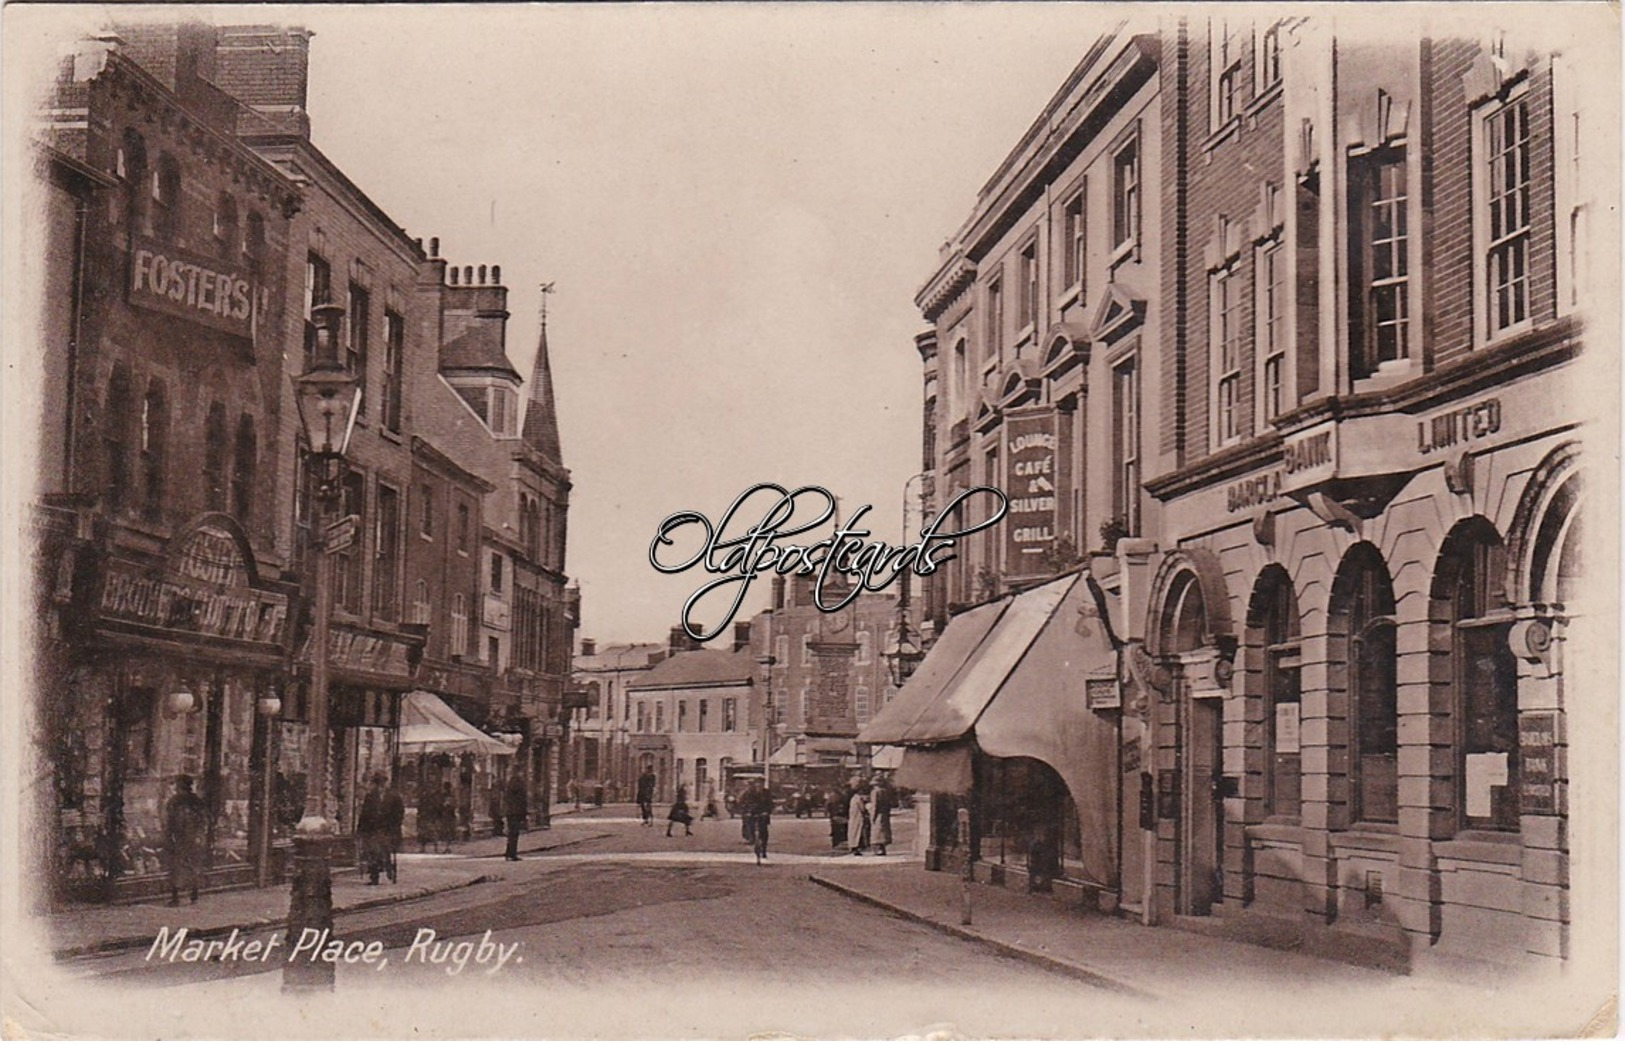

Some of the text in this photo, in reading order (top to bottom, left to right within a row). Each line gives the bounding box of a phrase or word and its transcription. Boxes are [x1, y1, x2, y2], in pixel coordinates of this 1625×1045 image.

[133, 250, 251, 320] FOSTER'S
[1009, 433, 1055, 453] LOUNGE
[1285, 431, 1332, 474] BANK
[1418, 398, 1502, 455] LIMITED
[1015, 455, 1053, 476] CAFÉ
[1010, 497, 1055, 513] SILVER
[1013, 527, 1056, 542] GRILL
